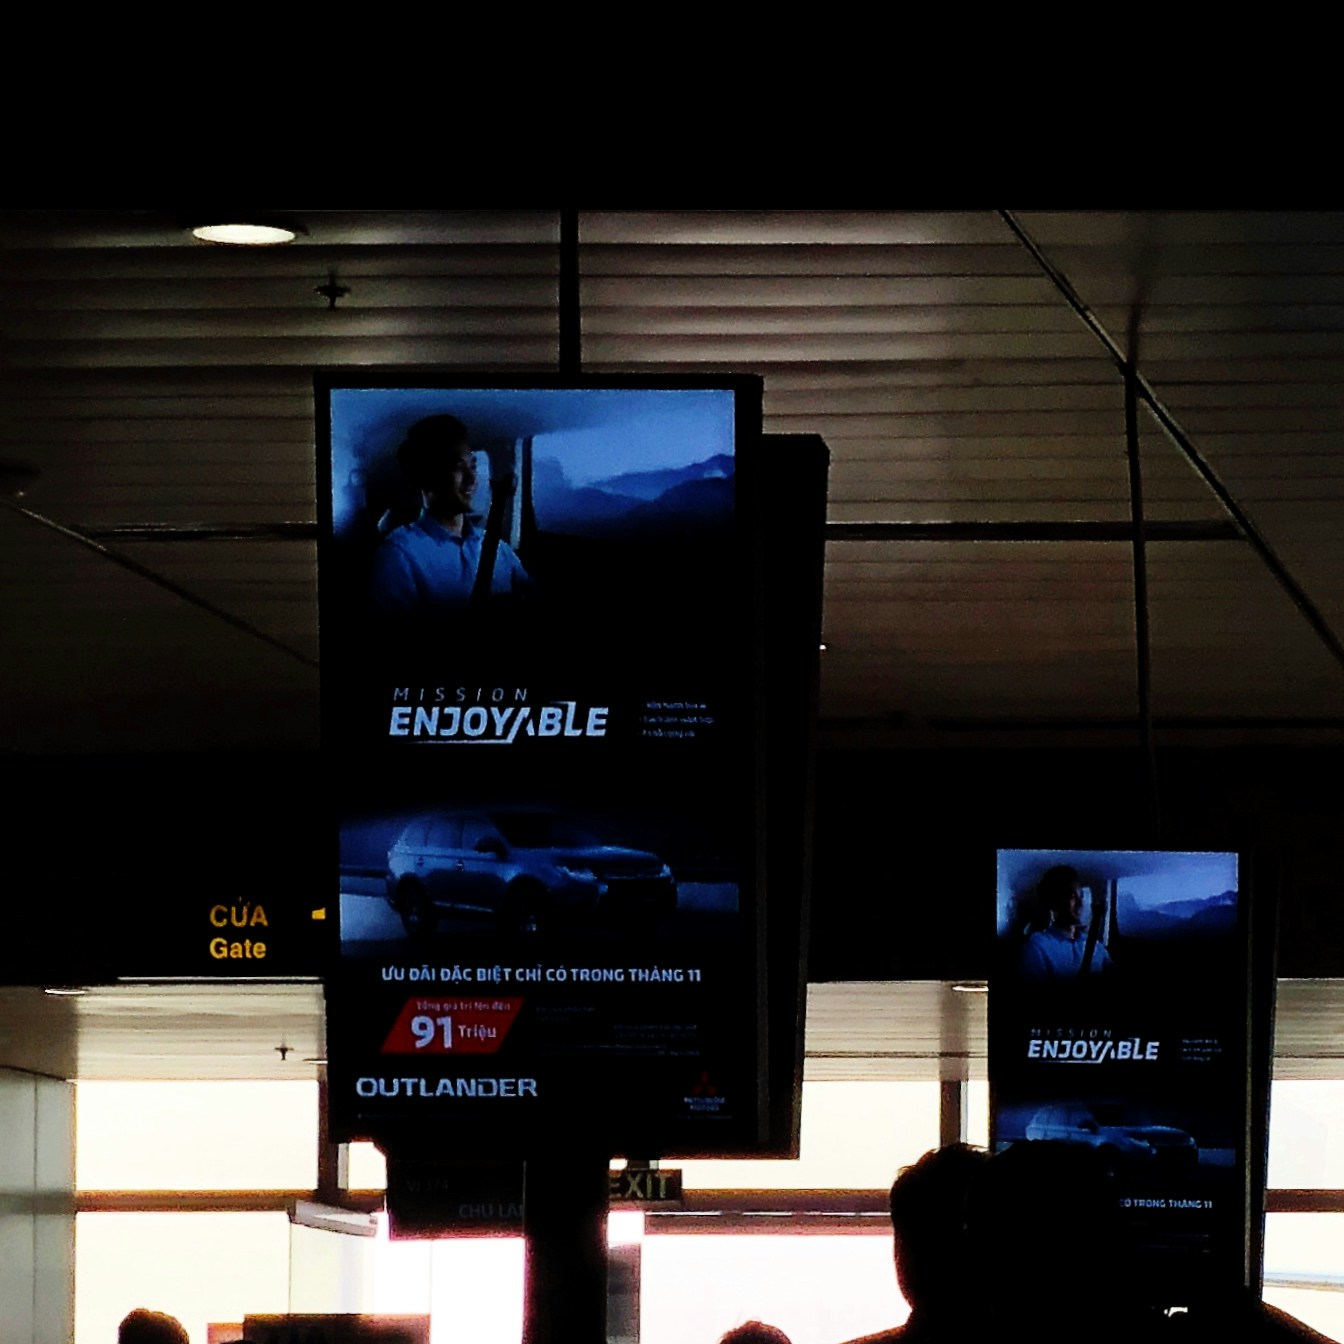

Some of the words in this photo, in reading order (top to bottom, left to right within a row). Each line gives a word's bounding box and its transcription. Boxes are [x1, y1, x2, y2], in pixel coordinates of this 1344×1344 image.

[392, 687, 528, 702] MISSION
[388, 700, 611, 744] ENJOYABLE
[209, 936, 267, 960] Gate
[570, 968, 625, 982] TRONG
[627, 965, 684, 982] THÁNG
[687, 968, 701, 982] 11
[410, 1015, 453, 1049] 91
[1030, 1028, 1112, 1039] MISSION
[1026, 1037, 1160, 1064] ENJOYABLE
[355, 1077, 539, 1097] OUTLANDER
[608, 1171, 673, 1199] EXIT
